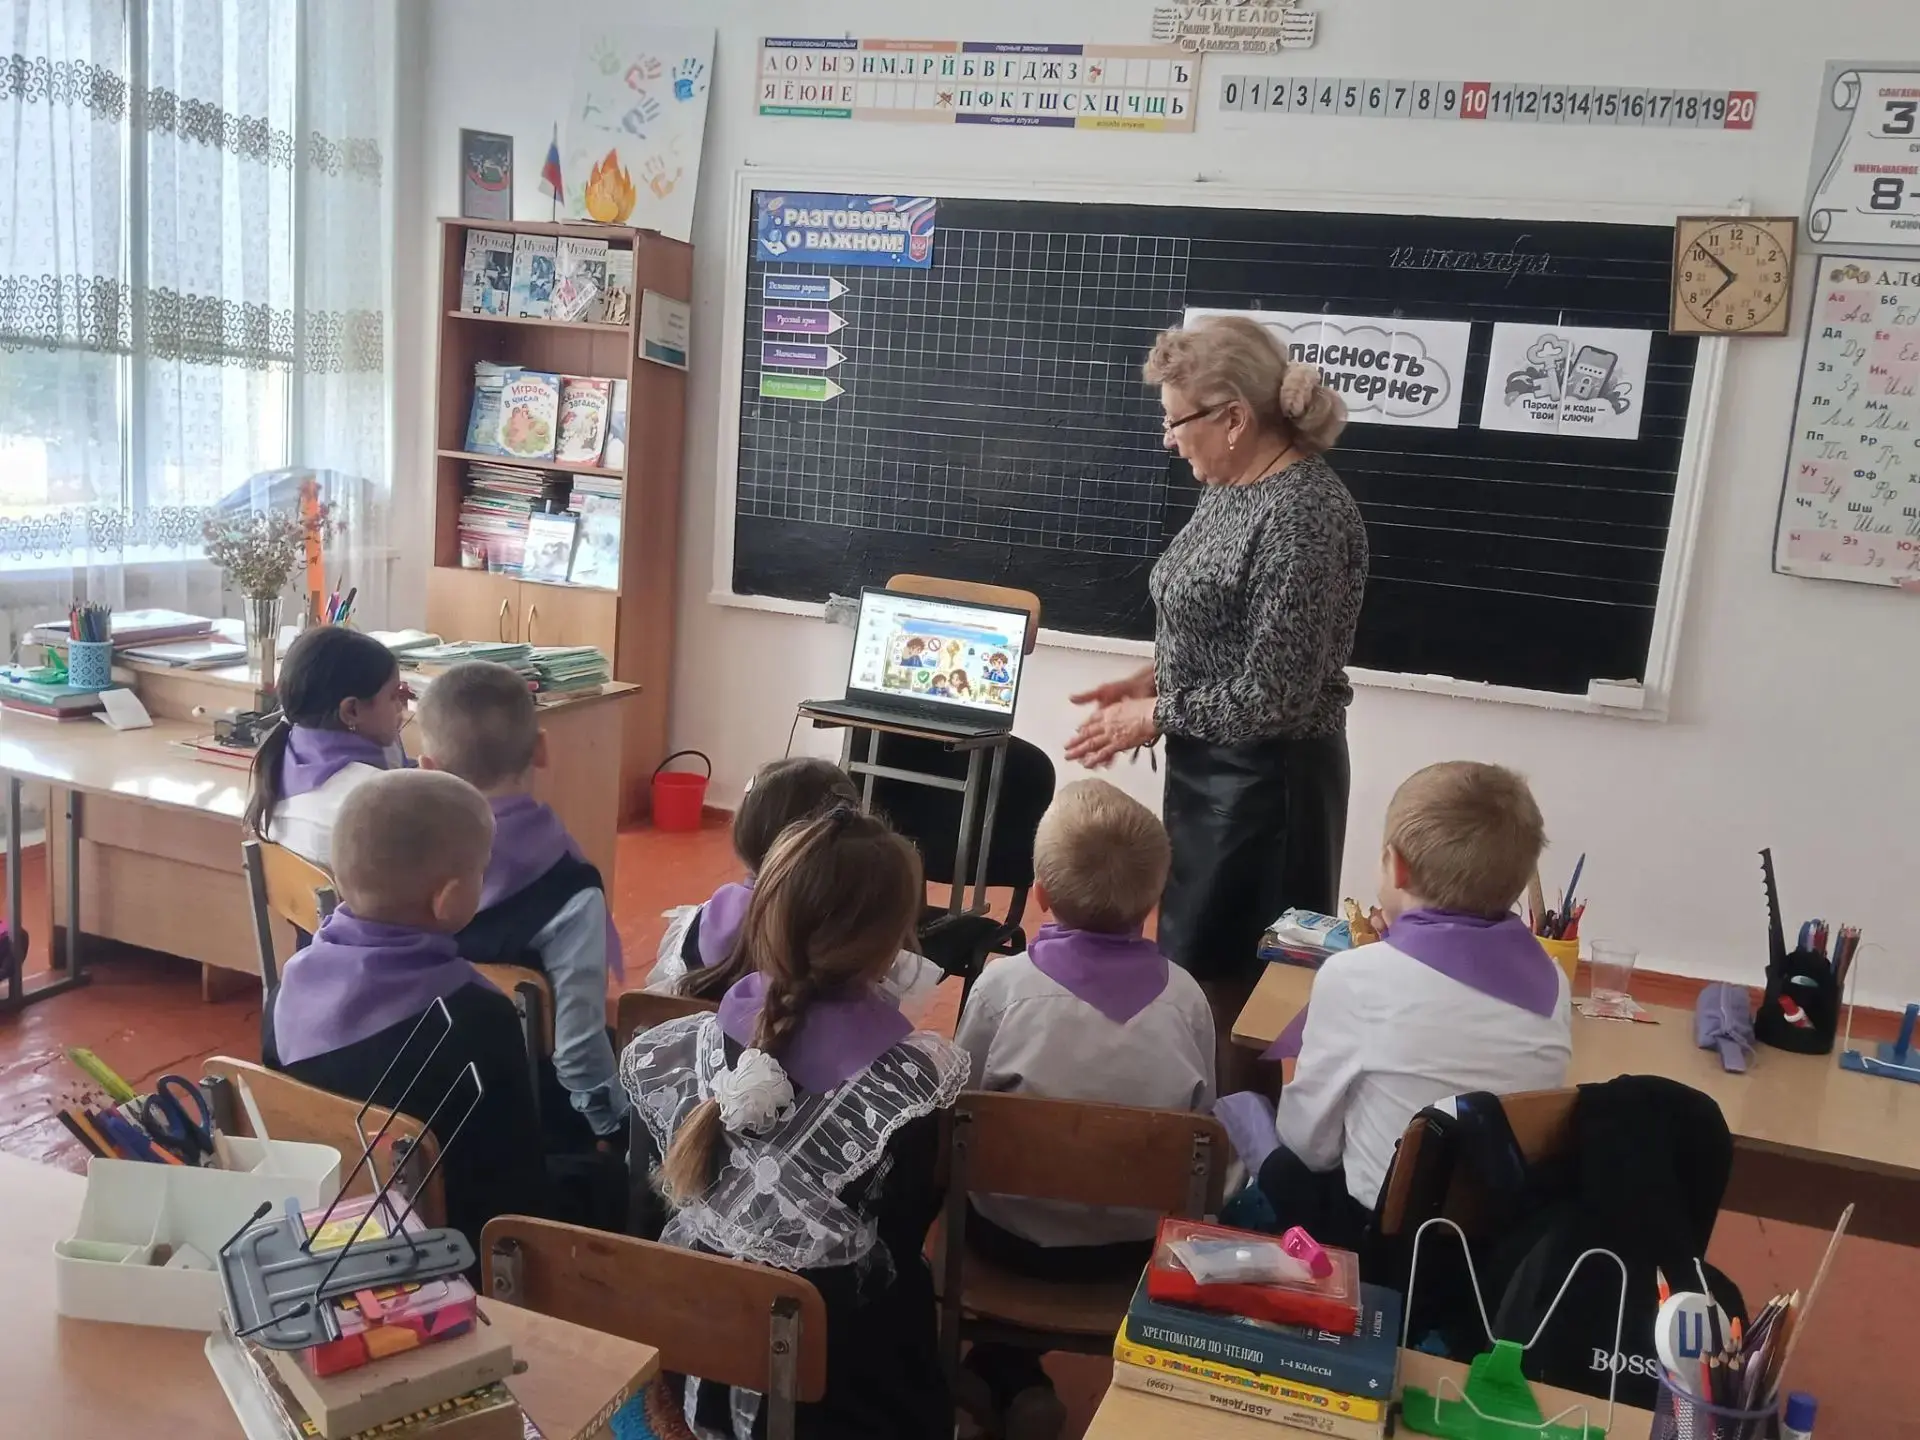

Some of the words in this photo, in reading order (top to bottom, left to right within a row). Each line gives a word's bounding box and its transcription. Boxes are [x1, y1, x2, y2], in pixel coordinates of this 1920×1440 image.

[1184, 8, 1280, 23] УЧИТЕЛЮ
[766, 57, 777, 70] А
[786, 55, 798, 71] О
[805, 56, 816, 71] У
[822, 56, 837, 71] Ы
[844, 56, 854, 72] Э
[863, 57, 875, 72] Н
[880, 58, 895, 73] М
[901, 58, 914, 74] Л
[923, 58, 934, 74] Р
[941, 56, 955, 75] Й
[963, 60, 975, 76] Б
[984, 60, 995, 76] В
[1004, 61, 1016, 77] Г
[1023, 62, 1036, 80] Д
[1042, 62, 1061, 79] Ж
[1068, 63, 1077, 79] З
[1175, 66, 1188, 82] Ъ
[765, 84, 776, 99] Я
[784, 81, 794, 100] Ё
[800, 85, 817, 100] Ю
[822, 86, 833, 101] И
[842, 86, 851, 101] Е
[959, 90, 972, 106] П
[979, 92, 993, 107] Ф
[1000, 92, 1014, 107] К
[1023, 93, 1034, 108] Т
[1039, 94, 1058, 109] Ш
[1063, 94, 1077, 110] С
[1084, 95, 1097, 110] Х
[1106, 95, 1120, 115] Ц
[1128, 96, 1140, 112] Ч
[1146, 97, 1165, 116] Щ
[1172, 97, 1183, 114] Ь
[1226, 83, 1237, 103] 0
[1250, 84, 1260, 104] 1
[1272, 85, 1285, 106] 2
[1296, 85, 1308, 106] 3
[1320, 86, 1332, 107] 4
[1344, 86, 1356, 108] 5
[1369, 87, 1381, 108] 6
[1395, 88, 1406, 109] 7
[1418, 88, 1430, 110] 8
[1443, 89, 1456, 111] 9
[1464, 89, 1486, 112] 10
[1491, 90, 1512, 113] 11
[1515, 91, 1537, 113] 12
[1541, 92, 1564, 114] 13
[1568, 93, 1590, 115] 14
[1594, 93, 1617, 116] 15
[1621, 95, 1643, 118] 16
[1647, 95, 1672, 119] 17
[1674, 97, 1698, 120] 18
[1701, 97, 1725, 121] 19
[1726, 98, 1753, 122] 20
[1882, 101, 1918, 134] 3
[1870, 178, 1904, 211] 8
[784, 208, 911, 231] РАЗГОВОРЫ
[785, 230, 801, 248] О
[1709, 235, 1719, 246] 11
[1730, 229, 1744, 240] 12
[1755, 235, 1760, 246] 1
[1693, 250, 1705, 261] 10
[1768, 250, 1776, 261] 2
[1685, 271, 1692, 282] 9
[1773, 272, 1781, 283] 3
[1689, 292, 1697, 303] 8
[1764, 293, 1771, 304] 4
[1705, 309, 1712, 319] 7
[1725, 315, 1733, 325] 6
[1748, 309, 1755, 320] 5
[1288, 343, 1425, 377] пасность
[1523, 399, 1558, 410] Пароли
[1530, 411, 1554, 421] твои
[1562, 413, 1594, 423] ключи
[1142, 1325, 1206, 1350] ХРЕСТОМАТИЯ
[1208, 1340, 1222, 1354] ПО
[1223, 1343, 1264, 1364] ЧТЕНИЮ
[1295, 1361, 1332, 1377] КЛАССЫ
[1589, 1347, 1661, 1379] BOSS
[1210, 1394, 1272, 1416] АБВГДейка
